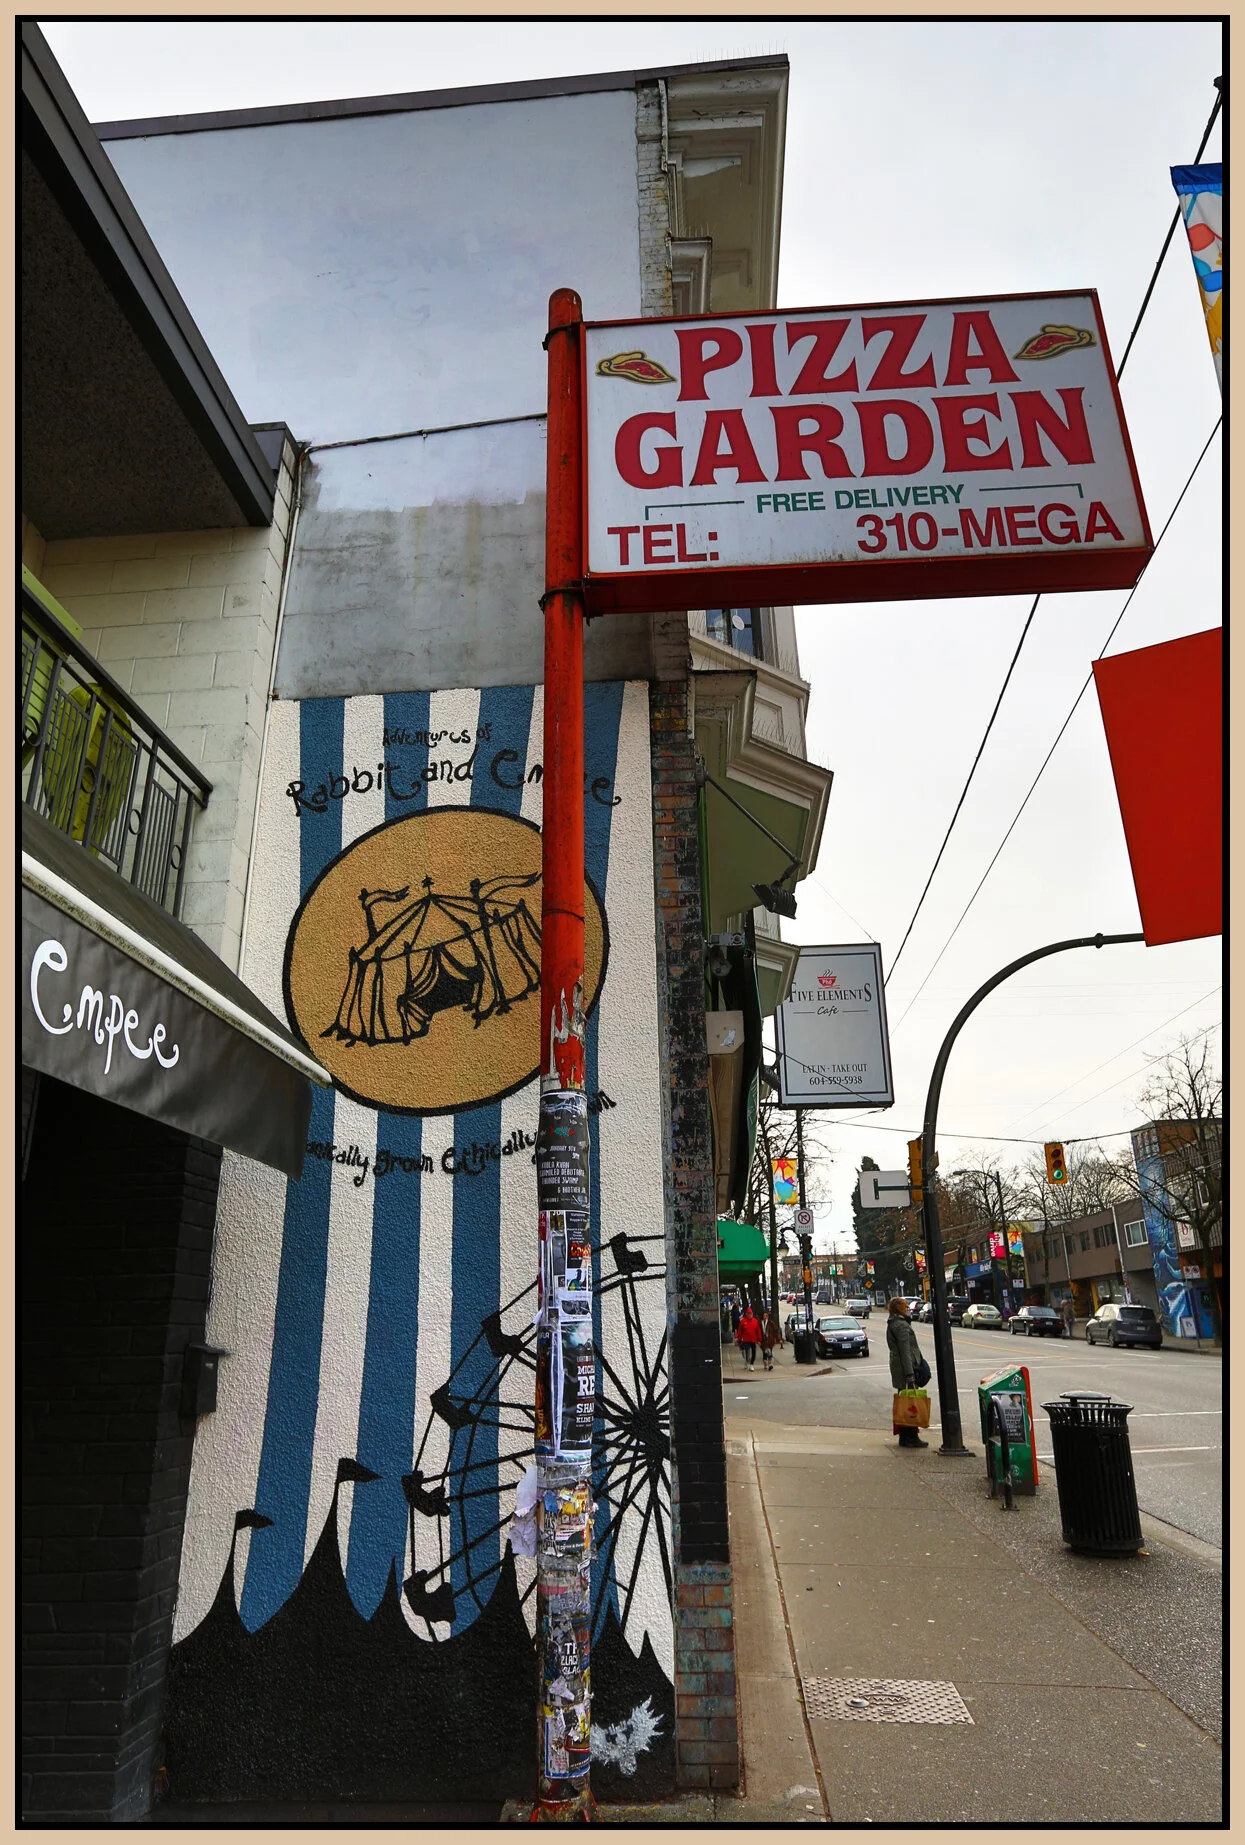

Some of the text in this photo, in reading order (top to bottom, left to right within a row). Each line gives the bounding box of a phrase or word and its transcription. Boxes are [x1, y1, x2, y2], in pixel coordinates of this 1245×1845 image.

[674, 310, 1021, 401] PIZZA
[614, 387, 1096, 490] GARDEN
[756, 484, 965, 514] FREE DELIVERY
[607, 501, 1124, 566] TEL: 310-MEGA
[476, 722, 493, 742] of
[286, 763, 421, 816] Rabbit
[421, 745, 478, 785] and
[789, 982, 872, 1003] FIVE ELEMENTS
[817, 1005, 839, 1016] Cafe
[802, 1064, 815, 1074] EAT
[817, 1064, 826, 1073] IN
[832, 1063, 850, 1073] TAKE
[852, 1063, 867, 1072] OUT
[809, 1075, 863, 1086] 604-559-5938
